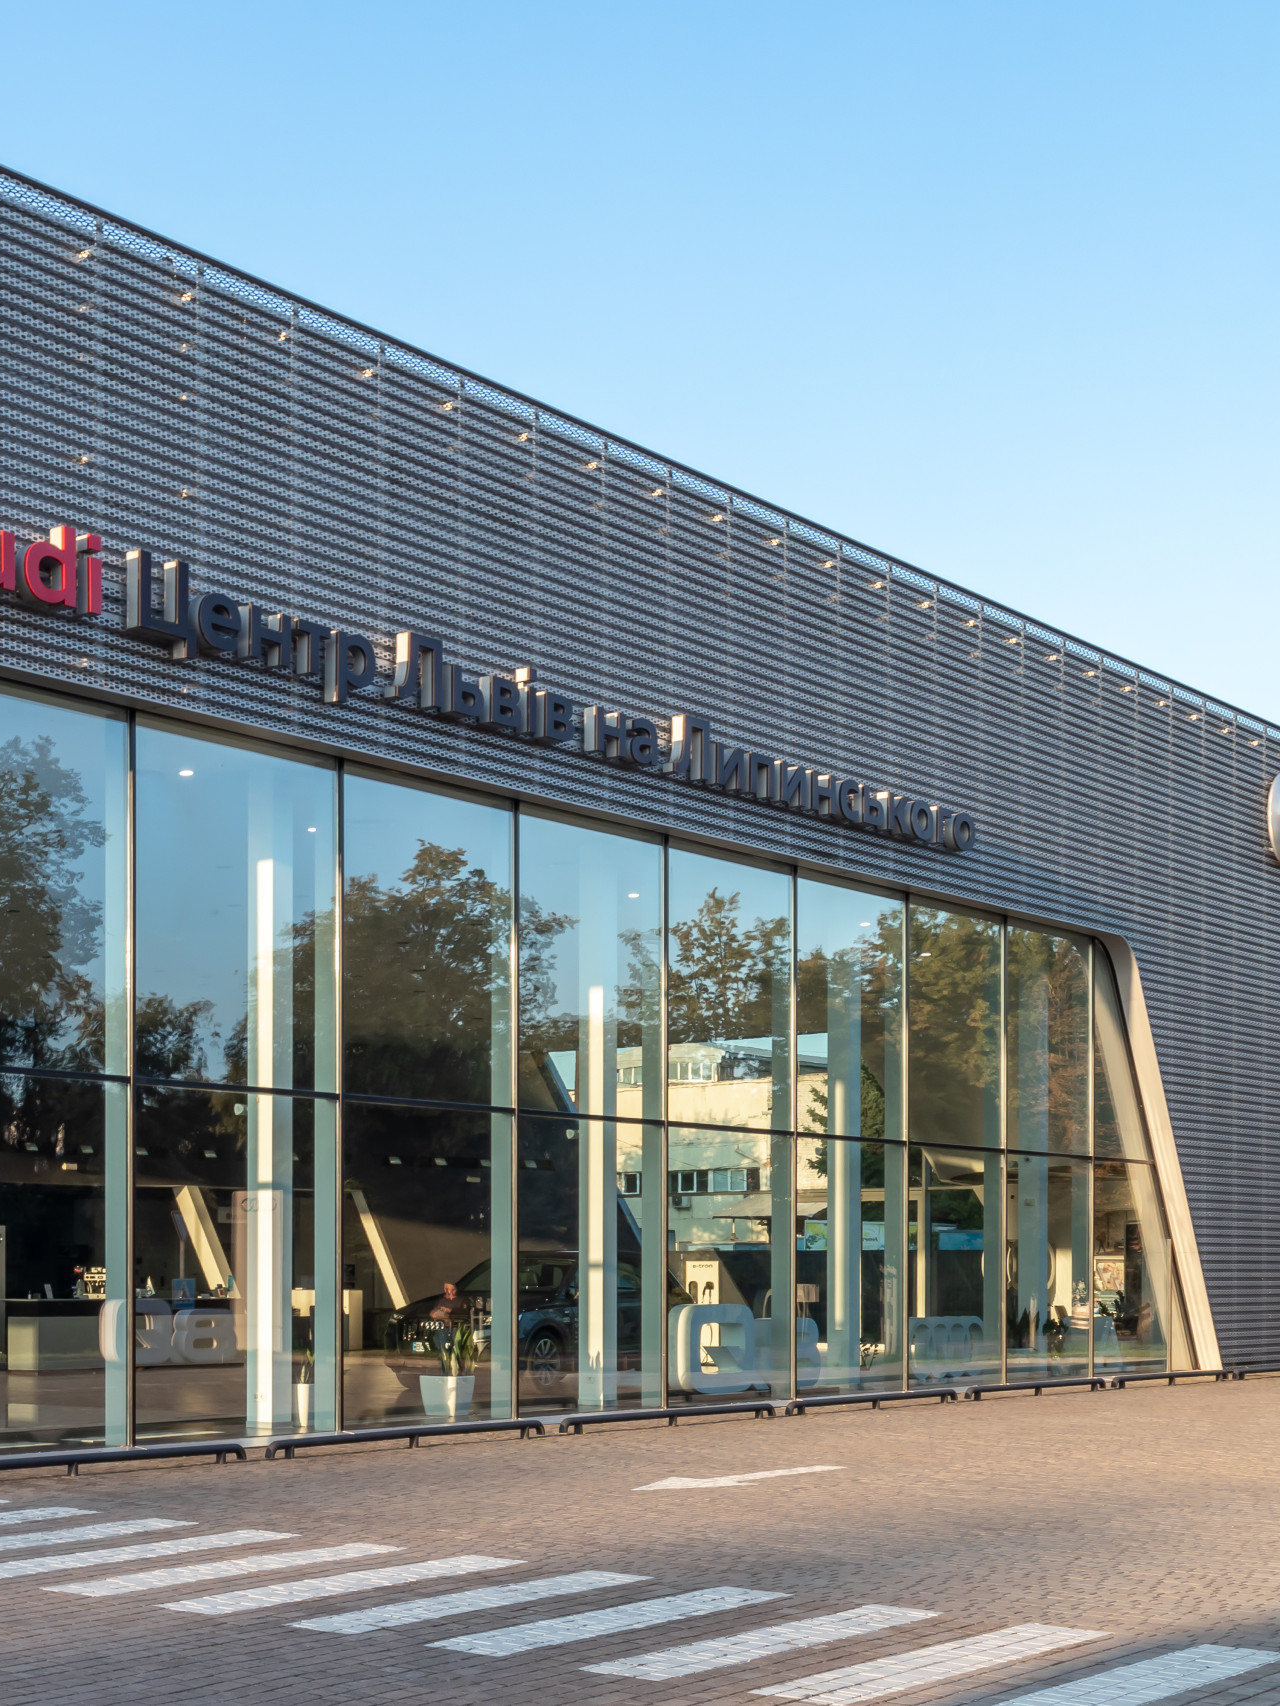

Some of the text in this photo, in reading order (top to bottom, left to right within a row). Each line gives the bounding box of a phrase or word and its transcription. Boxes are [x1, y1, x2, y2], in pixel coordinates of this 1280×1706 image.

[125, 549, 376, 702] Центр
[385, 631, 574, 746] Львів
[583, 704, 659, 766] на
[663, 714, 977, 852] Липинського
[99, 1298, 237, 1365] Q8
